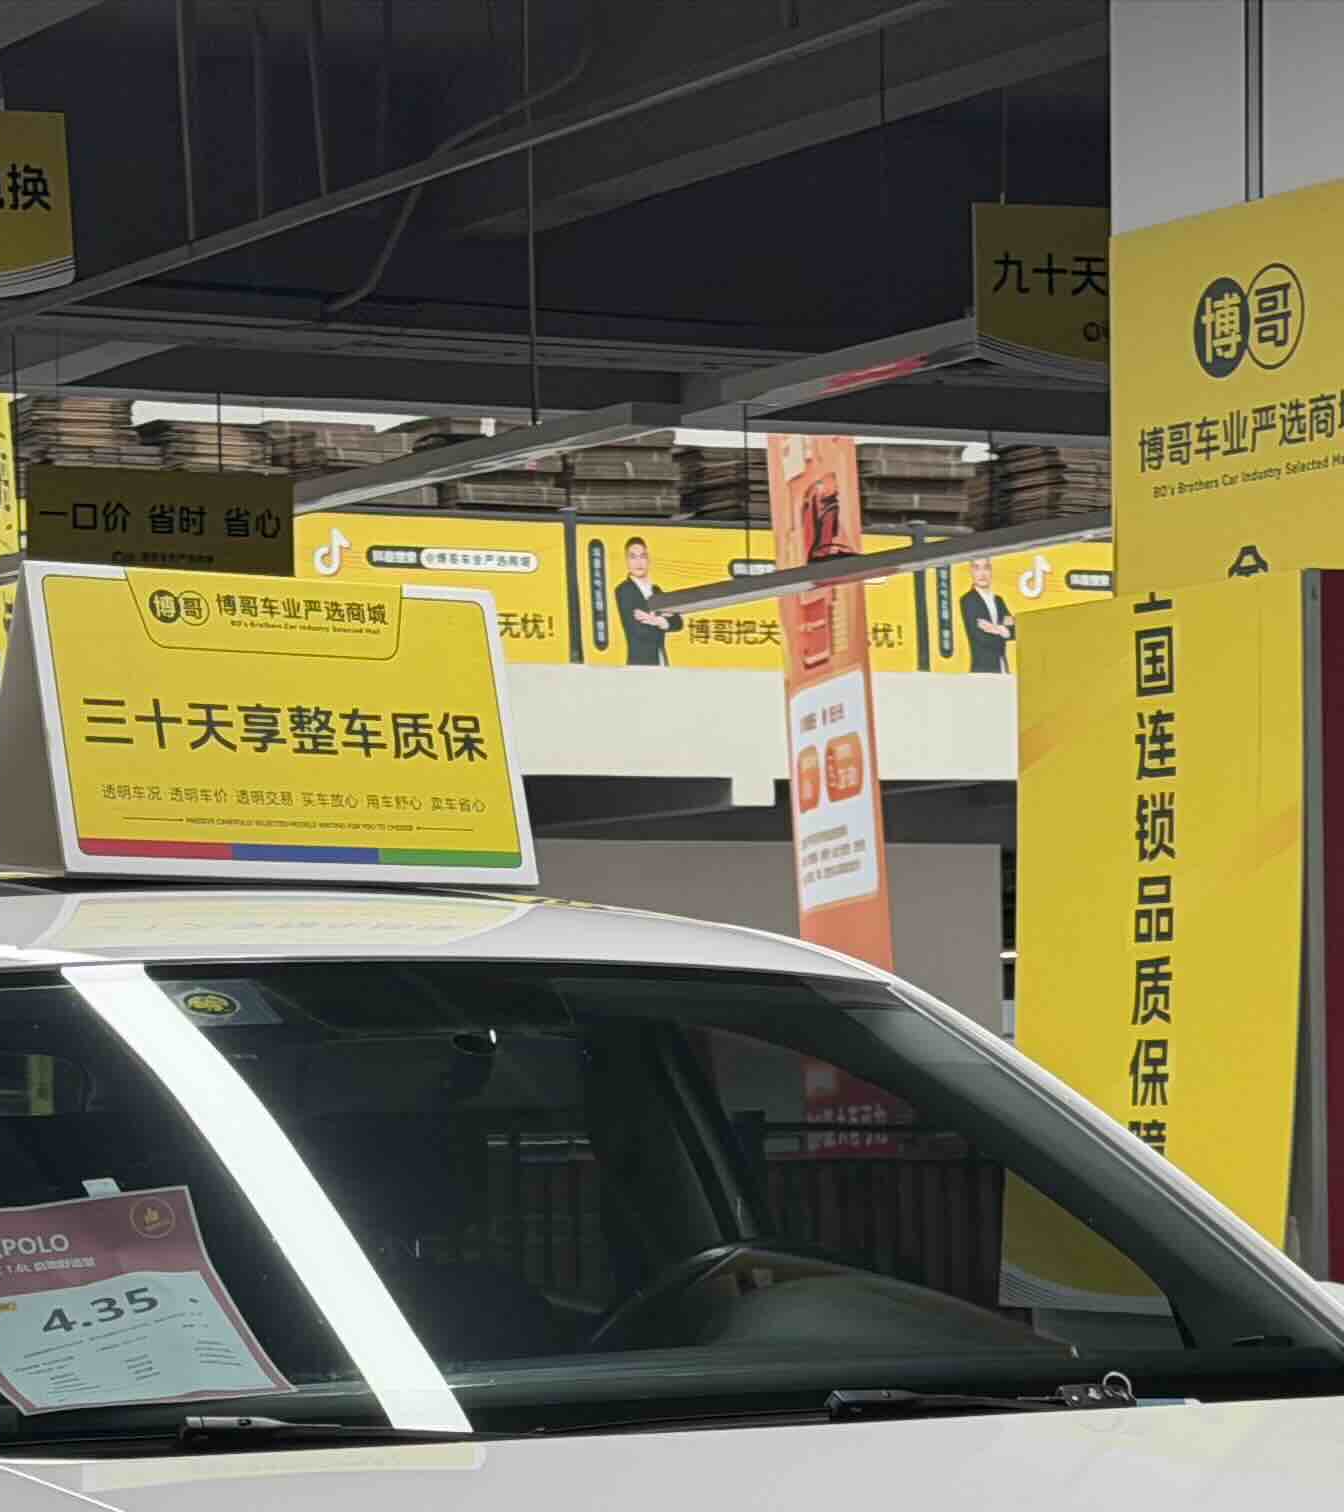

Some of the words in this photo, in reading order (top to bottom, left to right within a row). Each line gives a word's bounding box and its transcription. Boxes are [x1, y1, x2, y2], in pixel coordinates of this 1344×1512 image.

[992, 253, 1110, 296] 九十天
[1198, 270, 1299, 372] 博哥
[39, 502, 131, 534] 一口价
[148, 503, 206, 536] 省时
[223, 506, 281, 539] 省心
[216, 592, 389, 625] 博哥车业严选商城
[687, 618, 780, 647] 博哥把关
[82, 696, 488, 762] 三十天享整车质保
[102, 783, 162, 802] 透明车况
[236, 788, 294, 807] 透明交易
[301, 791, 359, 810] 买车放心
[41, 1287, 160, 1334] 4.35
